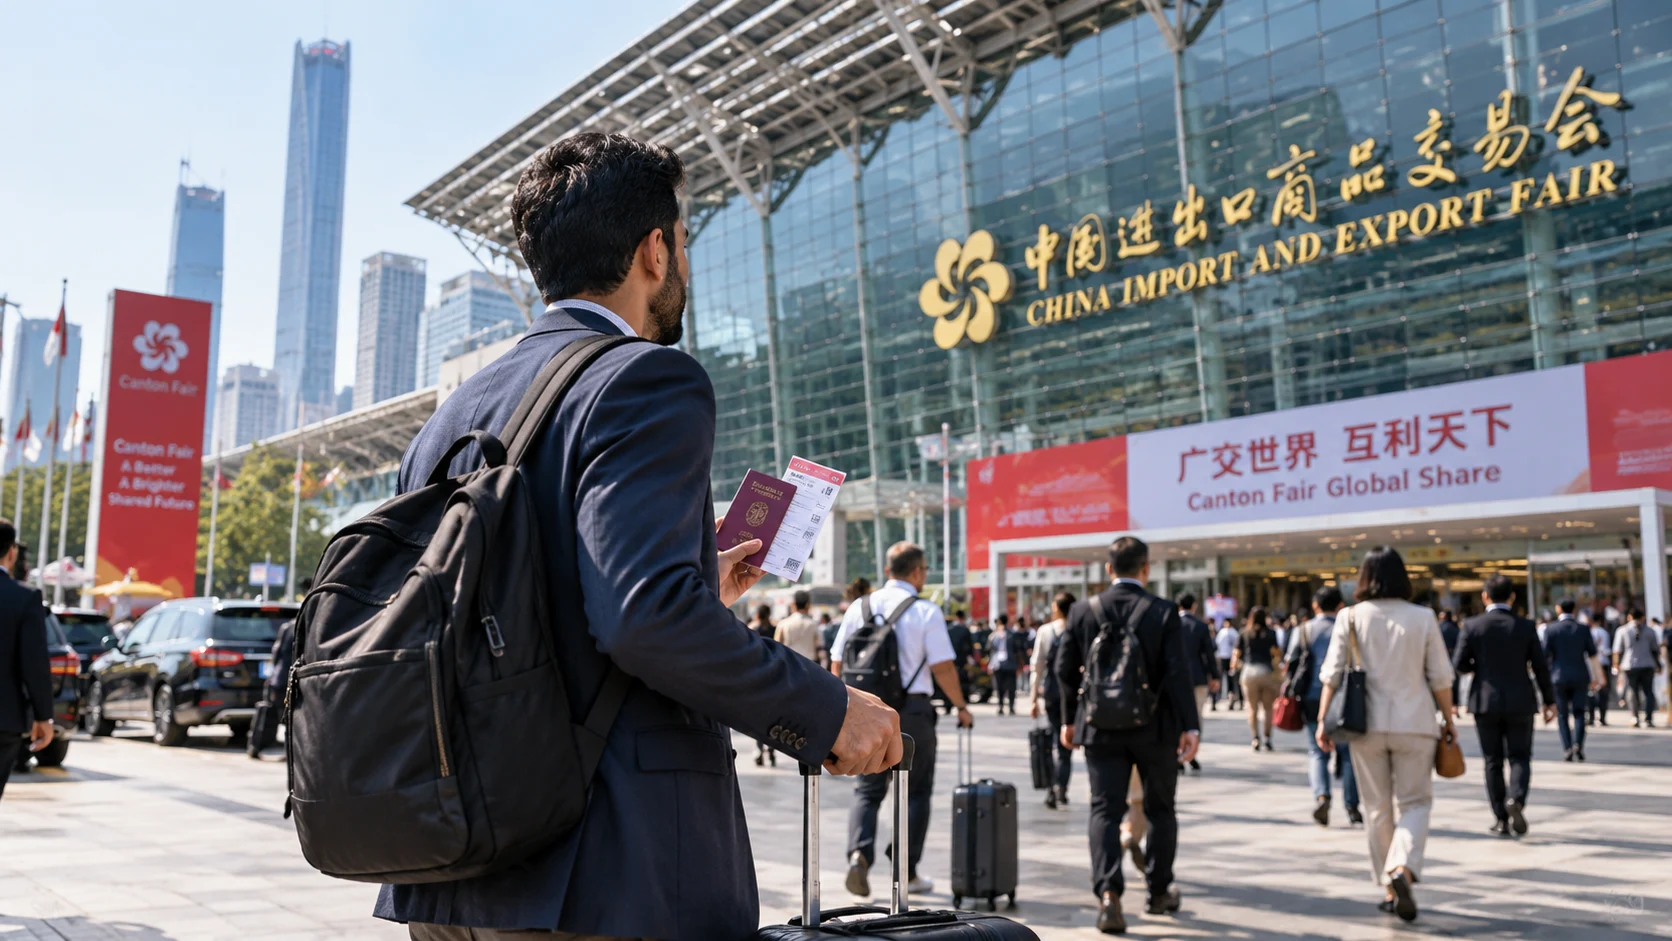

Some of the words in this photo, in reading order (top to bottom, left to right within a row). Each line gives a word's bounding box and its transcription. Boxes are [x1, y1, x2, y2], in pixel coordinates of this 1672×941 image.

[1024, 65, 1621, 291] 中国进出口商品交易会
[1026, 284, 1111, 327] CHINA
[1123, 250, 1238, 305] IMPORT
[1249, 231, 1321, 275] AND
[1335, 187, 1492, 255] EXPORT
[1509, 158, 1618, 214] FAIR
[119, 374, 168, 392] Canton
[171, 380, 198, 396] Fair
[113, 438, 165, 457] Canton
[167, 442, 195, 458] Fair
[1178, 431, 1319, 484] 广交世界
[1343, 403, 1514, 464] 互利天下
[121, 459, 132, 472] A
[134, 460, 176, 476] Better
[119, 476, 130, 489] A
[132, 477, 185, 493] Brighter
[1187, 489, 1265, 512] Canton
[1272, 481, 1317, 503] Fair
[1327, 469, 1409, 498] Global
[1419, 464, 1502, 489] Share
[108, 492, 152, 507] Shared
[154, 494, 195, 510] Future
